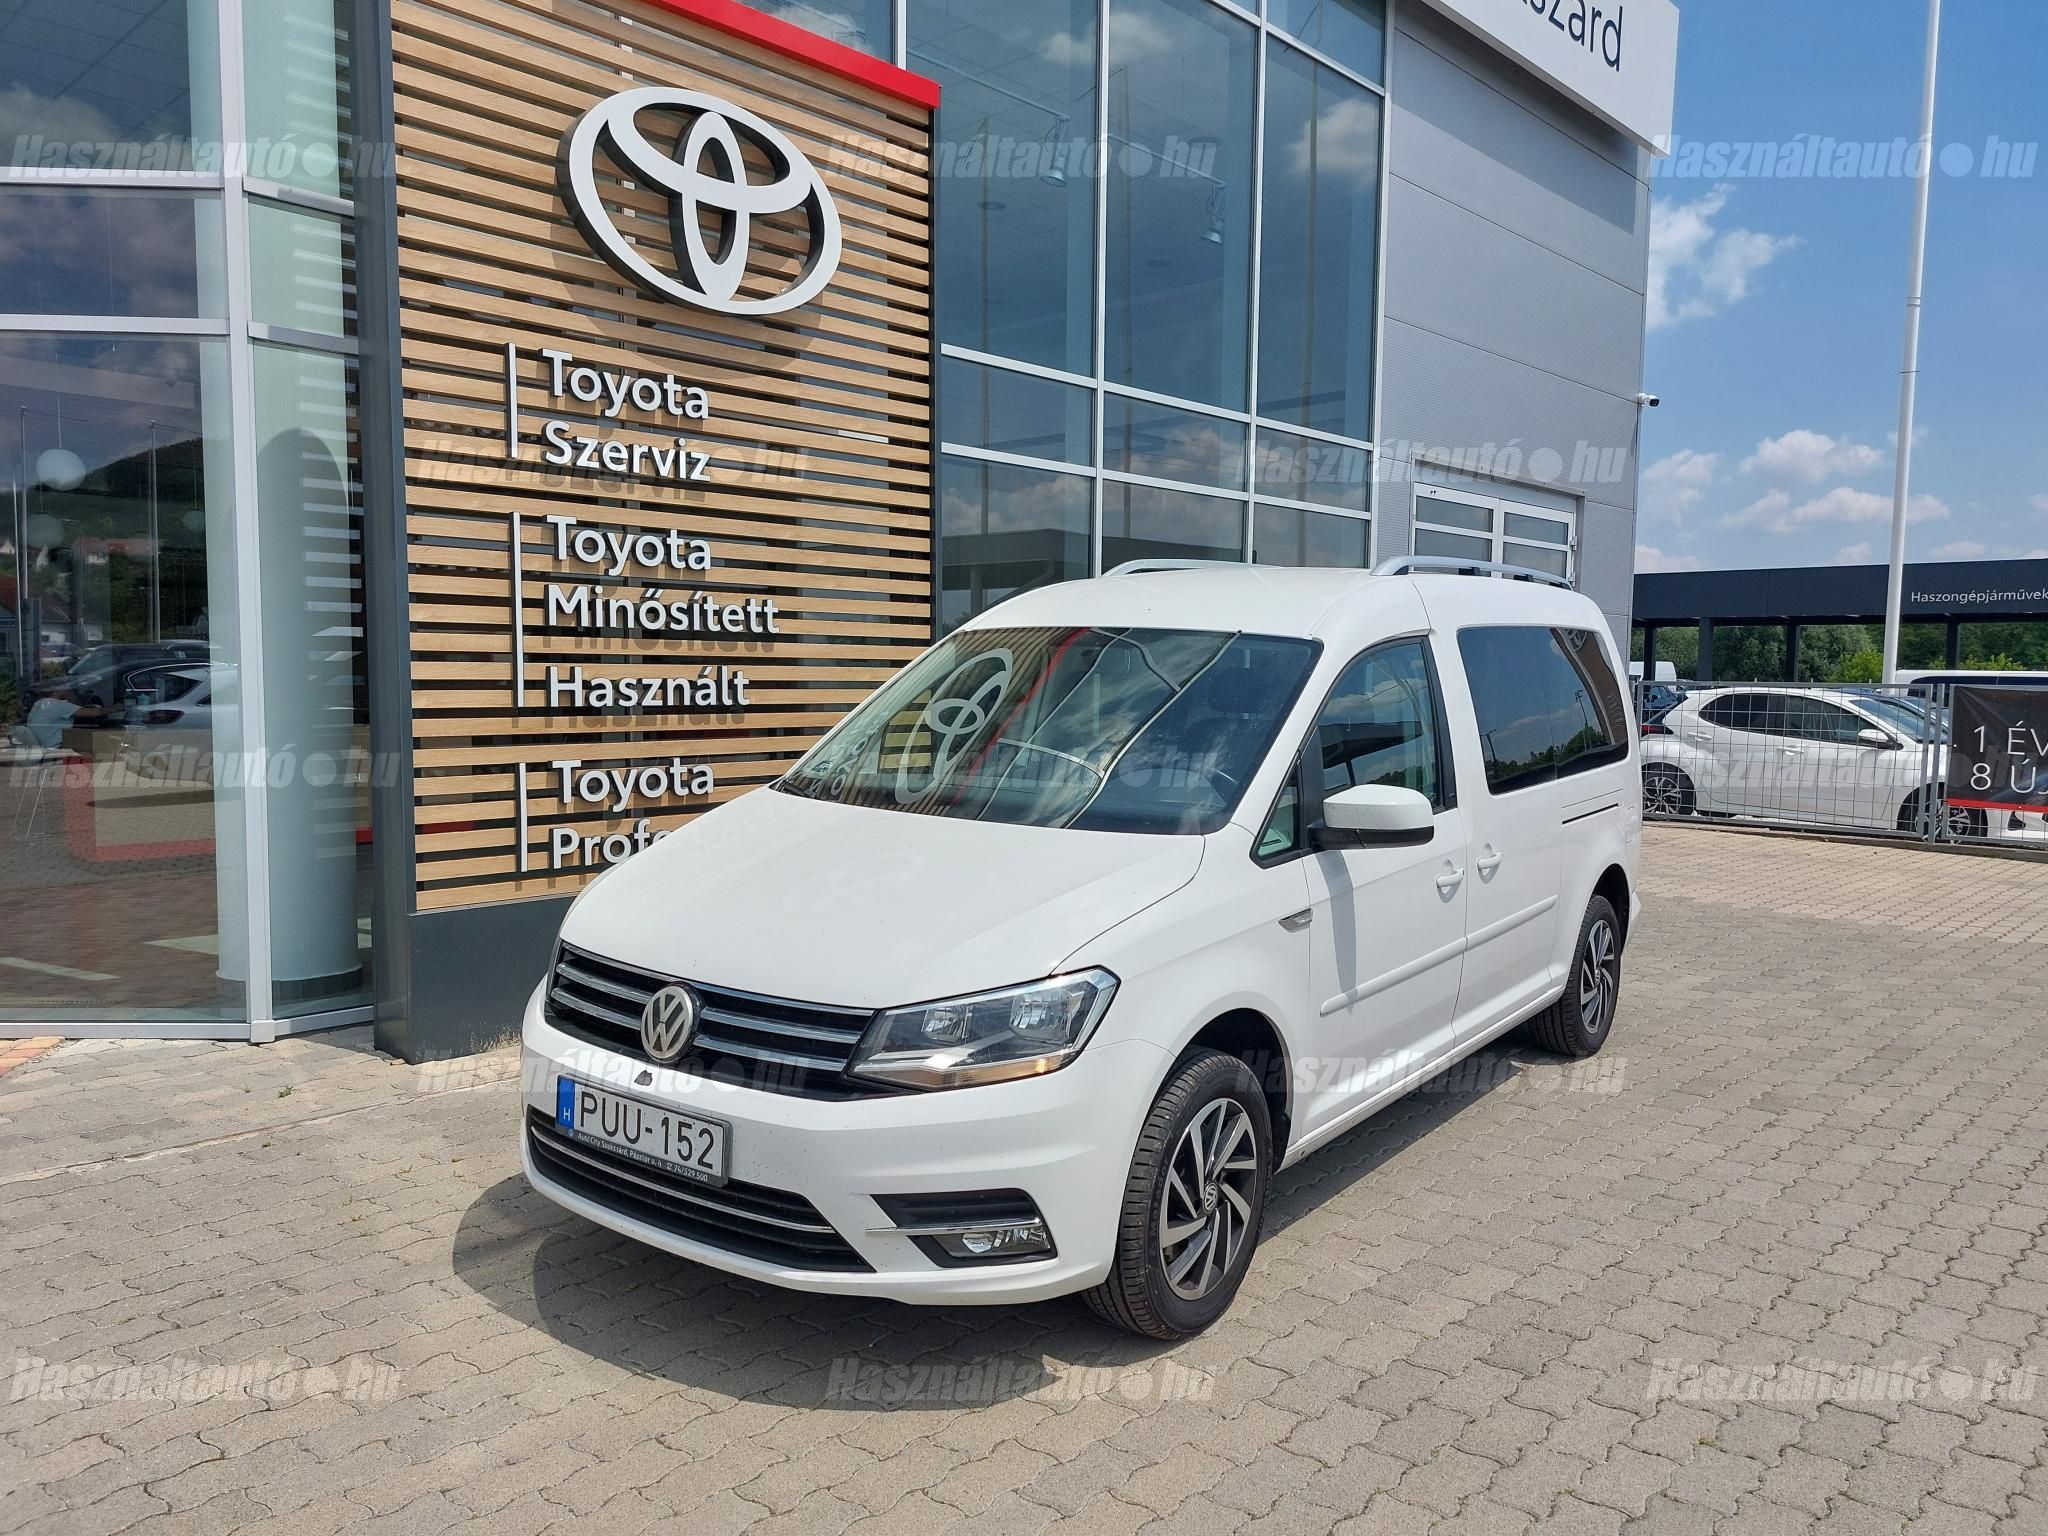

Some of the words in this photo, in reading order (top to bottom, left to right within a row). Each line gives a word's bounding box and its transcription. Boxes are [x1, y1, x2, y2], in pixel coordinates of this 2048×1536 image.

[542, 348, 710, 420] Toyota
[544, 420, 711, 482] Szerviz
[546, 515, 712, 577] Toyota
[545, 584, 780, 633] Minősített
[1911, 588, 2048, 604] Haszongépjárművek
[548, 665, 750, 707] Használt
[1974, 725, 1986, 753] 1
[552, 757, 715, 813] Toyota
[1970, 762, 1991, 791] 8
[2010, 758, 2048, 796] Ú
[563, 1107, 571, 1122] H
[580, 1090, 715, 1170] PUU-152
